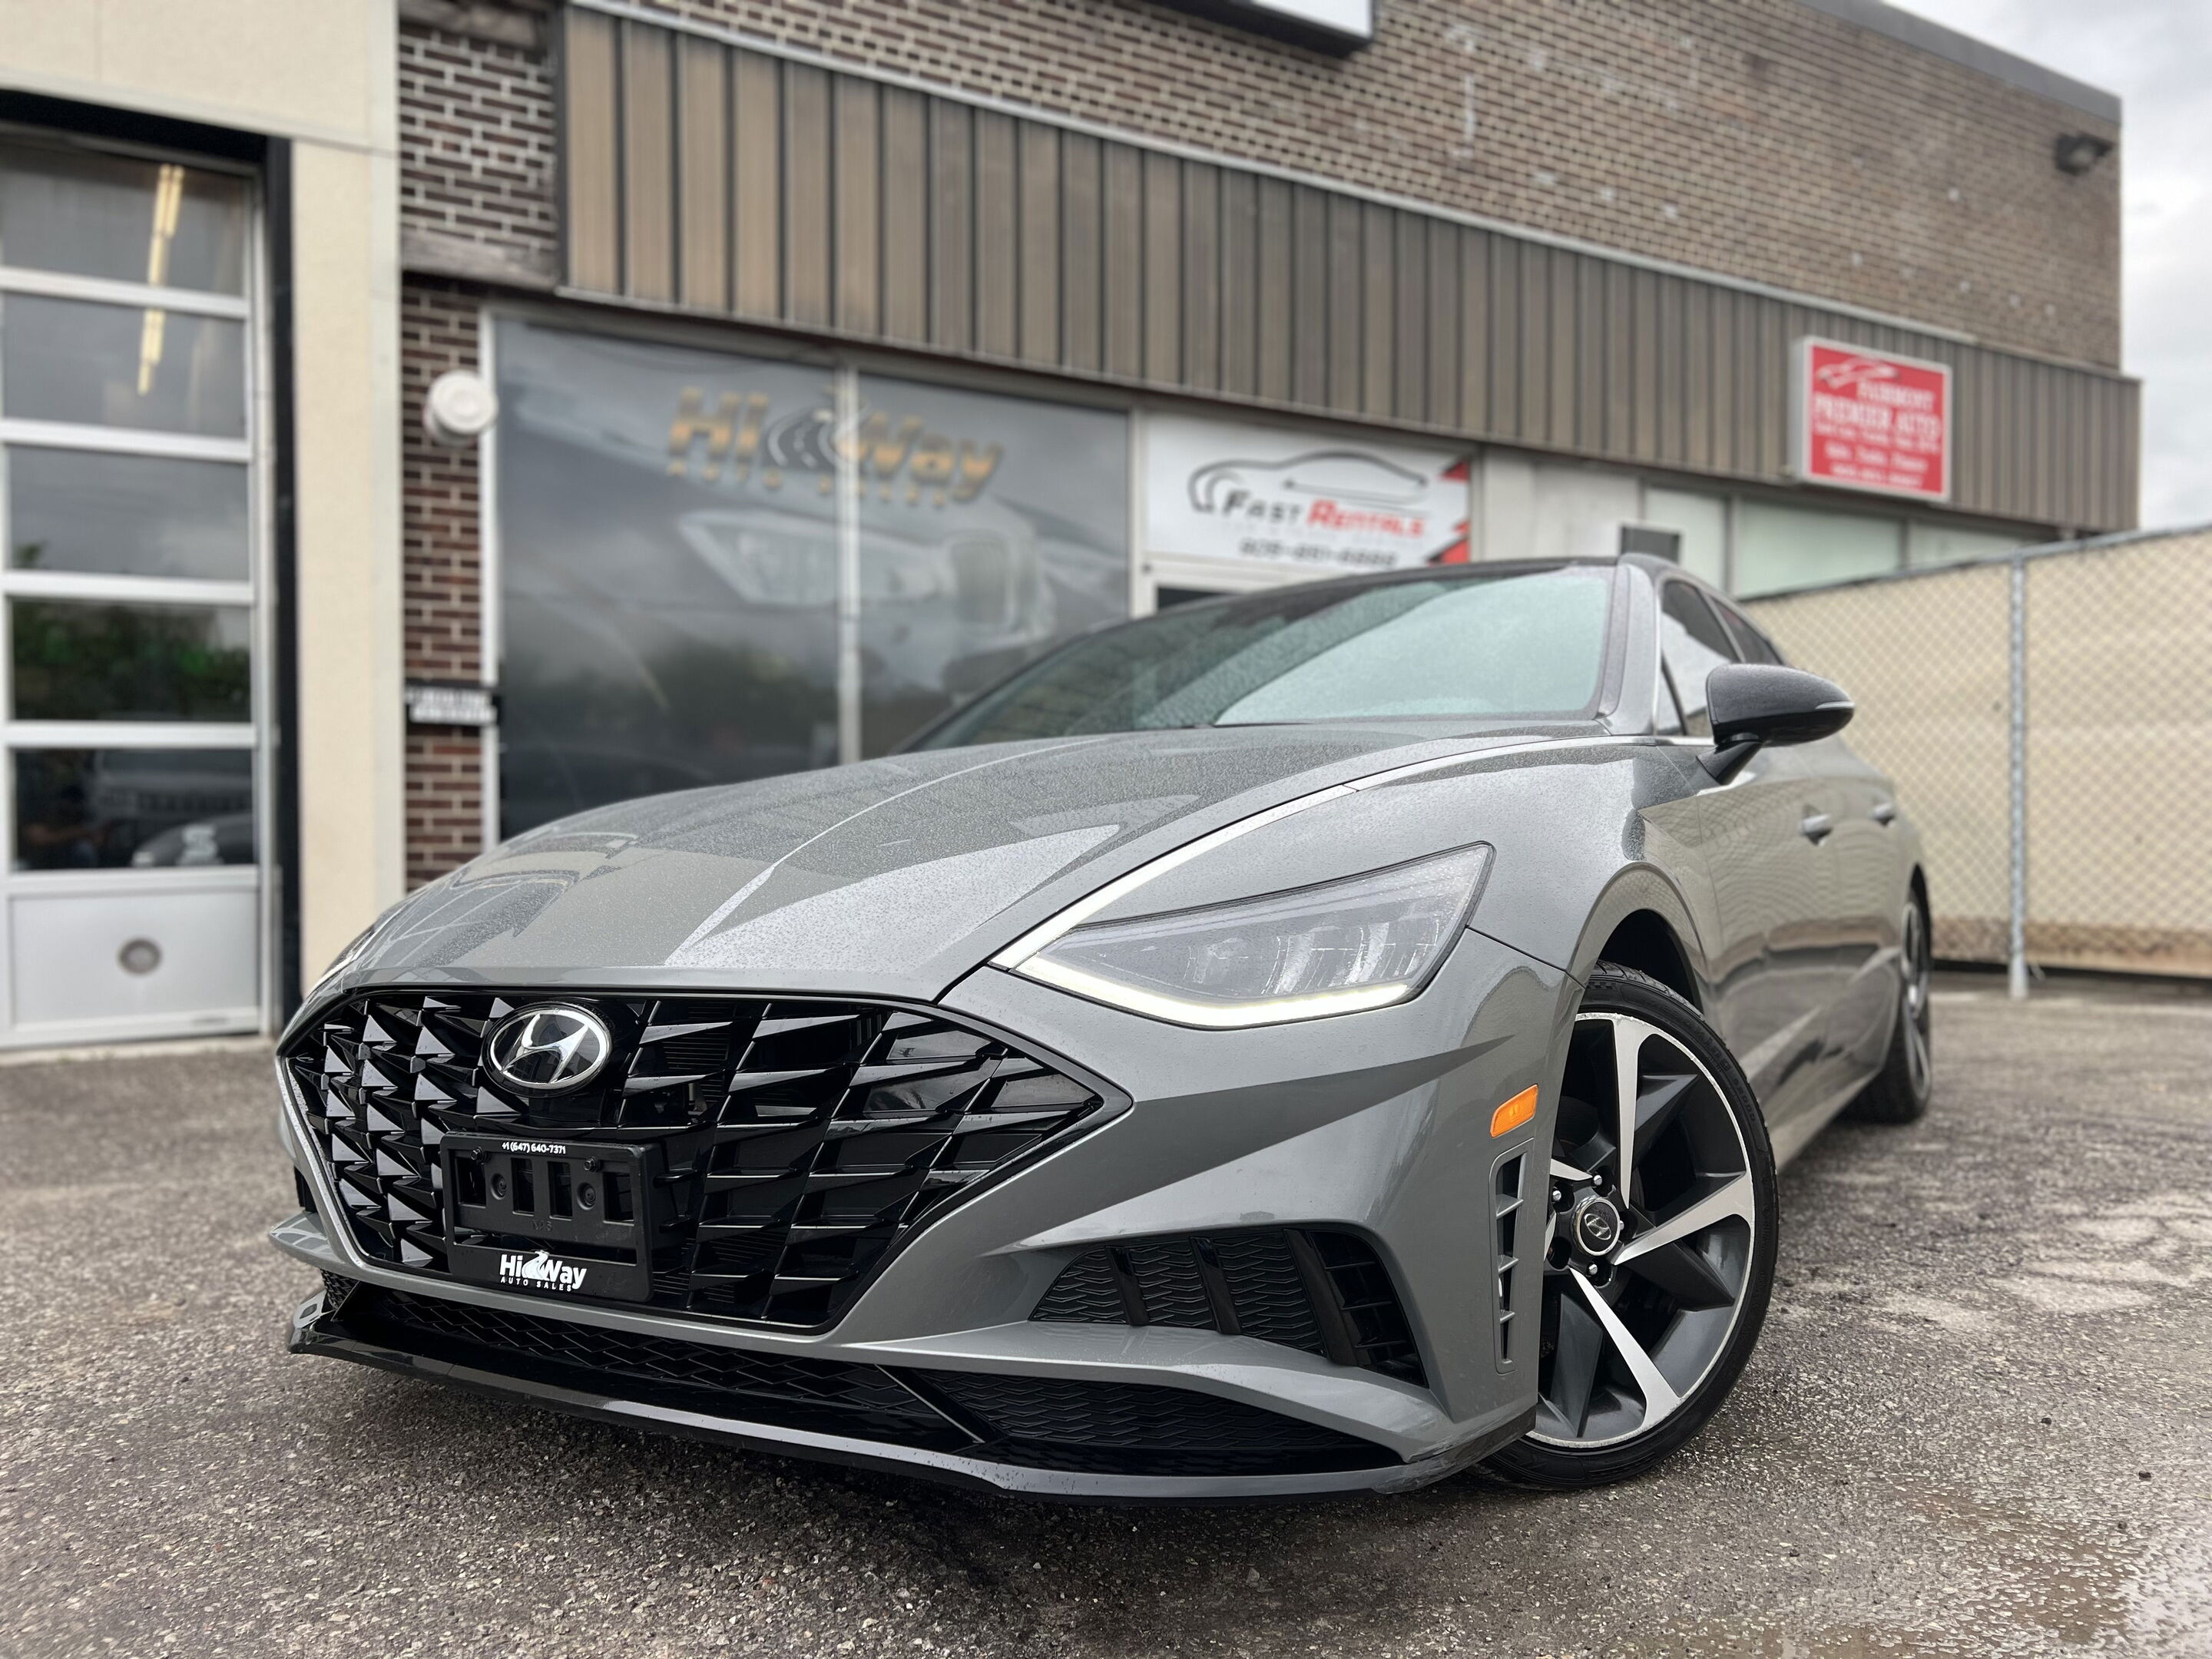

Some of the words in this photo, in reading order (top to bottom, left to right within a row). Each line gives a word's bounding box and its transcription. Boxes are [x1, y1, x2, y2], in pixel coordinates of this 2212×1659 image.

[510, 1141, 530, 1153] (647)
[531, 1143, 566, 1154] 640-7371
[500, 1276, 529, 1286] AUTO
[536, 1280, 571, 1292] SALES
